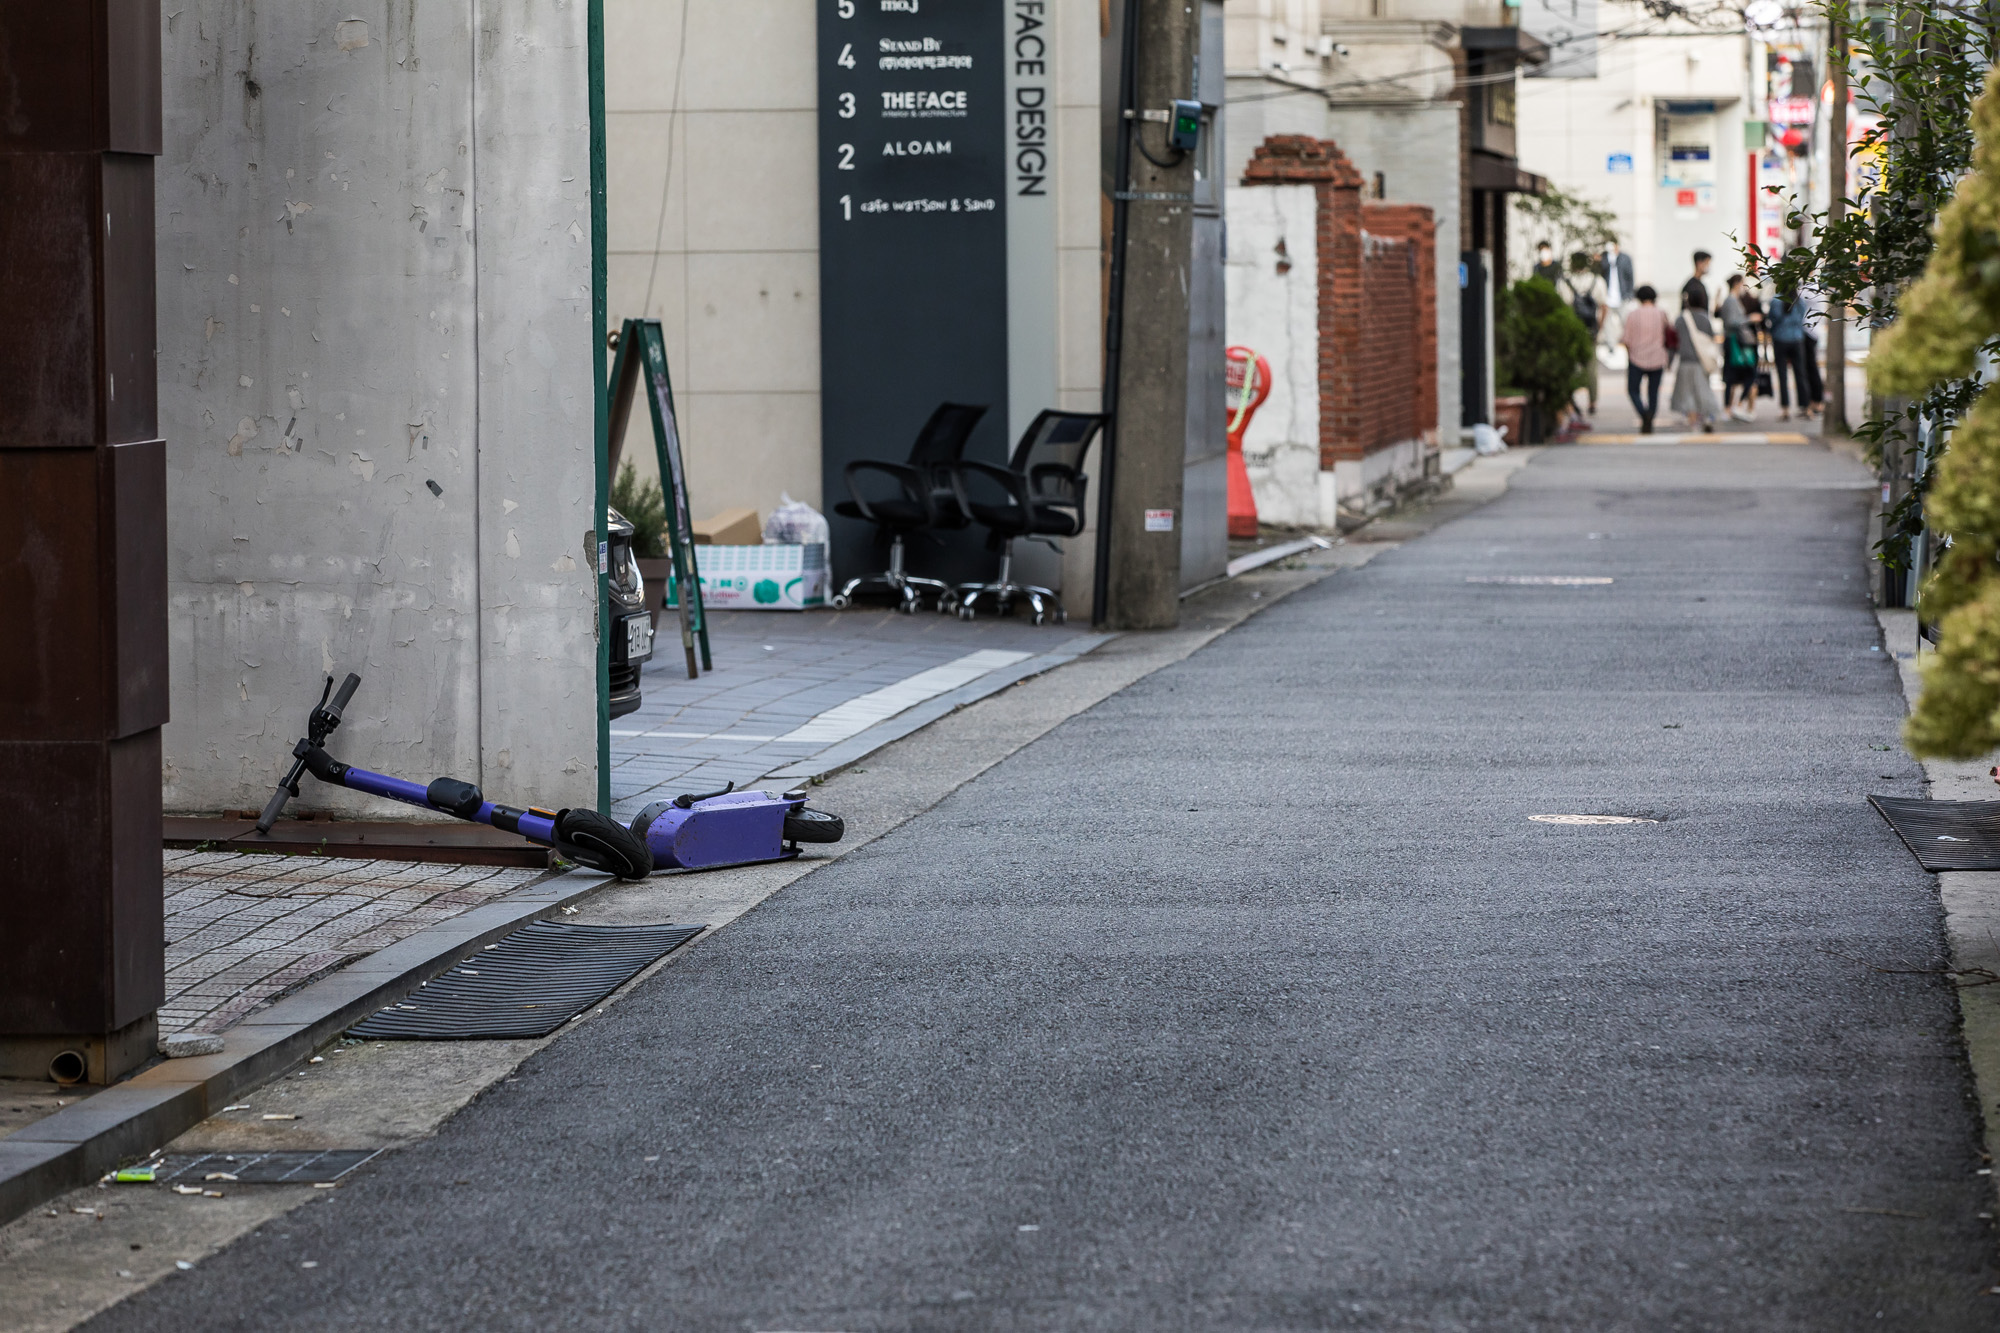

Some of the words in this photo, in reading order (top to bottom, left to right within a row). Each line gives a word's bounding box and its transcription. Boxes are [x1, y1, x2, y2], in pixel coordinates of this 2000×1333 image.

[838, 0, 855, 19] 5
[1015, 2, 1045, 75] FACE
[838, 43, 856, 69] 4
[839, 92, 856, 118] 3
[1016, 87, 1046, 196] DESIGN
[838, 143, 855, 170] 2
[883, 141, 951, 155] ALOAM
[840, 195, 851, 221] 1
